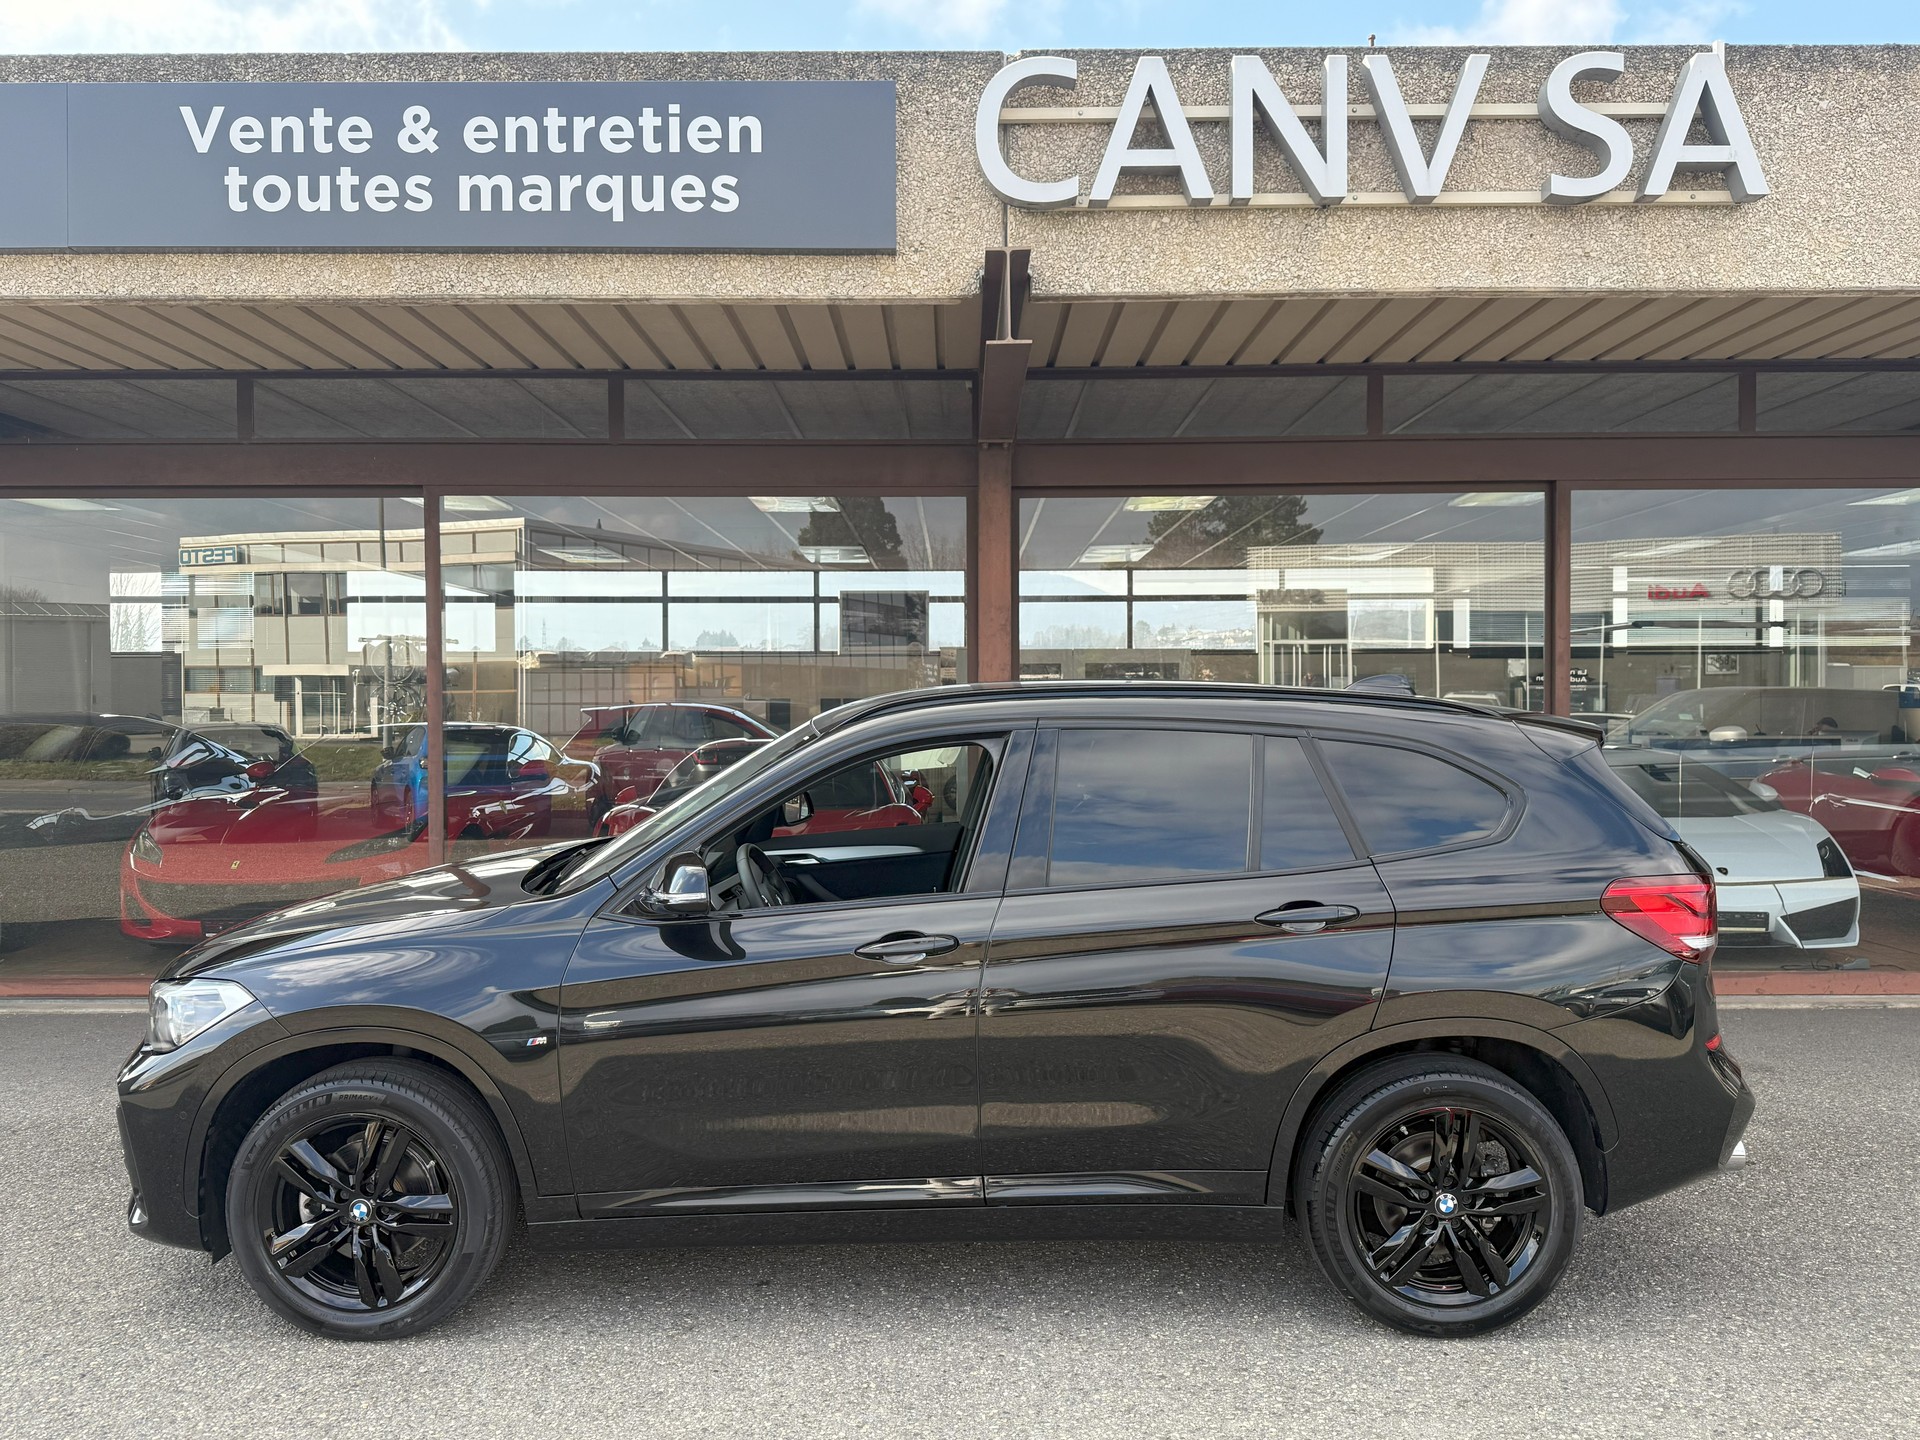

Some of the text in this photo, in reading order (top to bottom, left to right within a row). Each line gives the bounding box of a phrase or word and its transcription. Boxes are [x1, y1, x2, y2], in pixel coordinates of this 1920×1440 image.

[179, 104, 762, 153] Vente & entretien
[975, 50, 1770, 206] CANV SA
[224, 167, 740, 222] toutes marques
